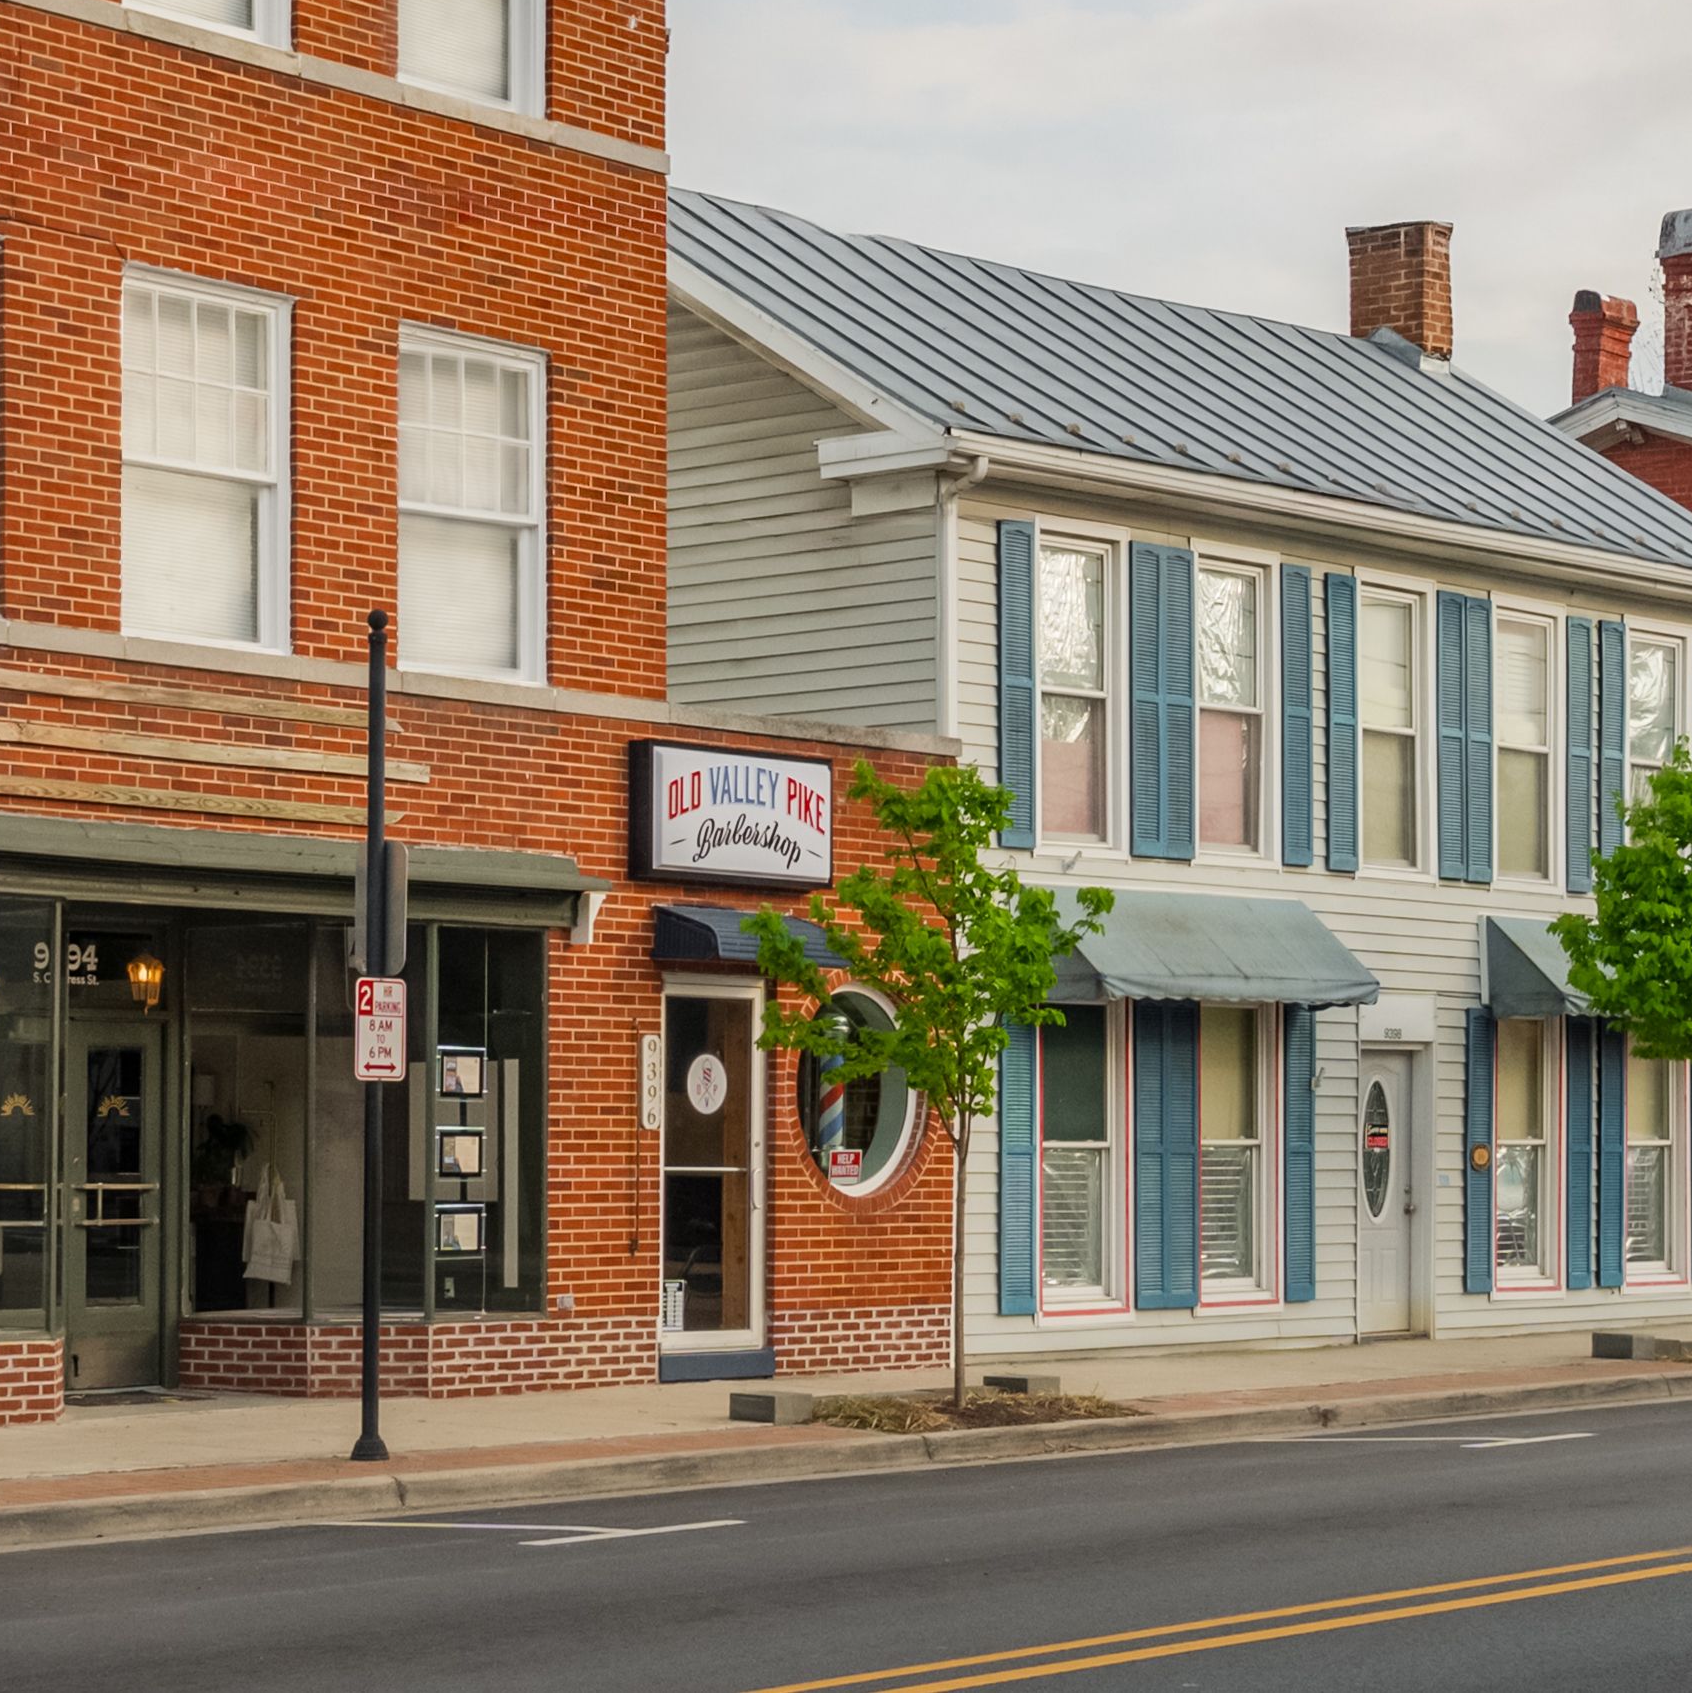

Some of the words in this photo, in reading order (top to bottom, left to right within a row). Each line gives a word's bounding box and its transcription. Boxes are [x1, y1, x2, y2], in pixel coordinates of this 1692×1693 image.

[668, 770, 702, 820] OLD
[709, 765, 780, 810] VALLEY
[787, 776, 826, 836] PIKE
[692, 813, 802, 870] Barbershop
[33, 941, 99, 972] 994
[360, 985, 372, 1011] 2
[374, 1000, 401, 1014] PARKING
[368, 1019, 376, 1032] 8
[377, 1019, 393, 1033] AM
[376, 1034, 386, 1044] TO
[368, 1046, 376, 1059] 6
[377, 1046, 392, 1059] PM
[646, 1038, 658, 1126] 9396
[837, 1153, 856, 1165] HELP
[831, 1164, 859, 1176] WANTED
